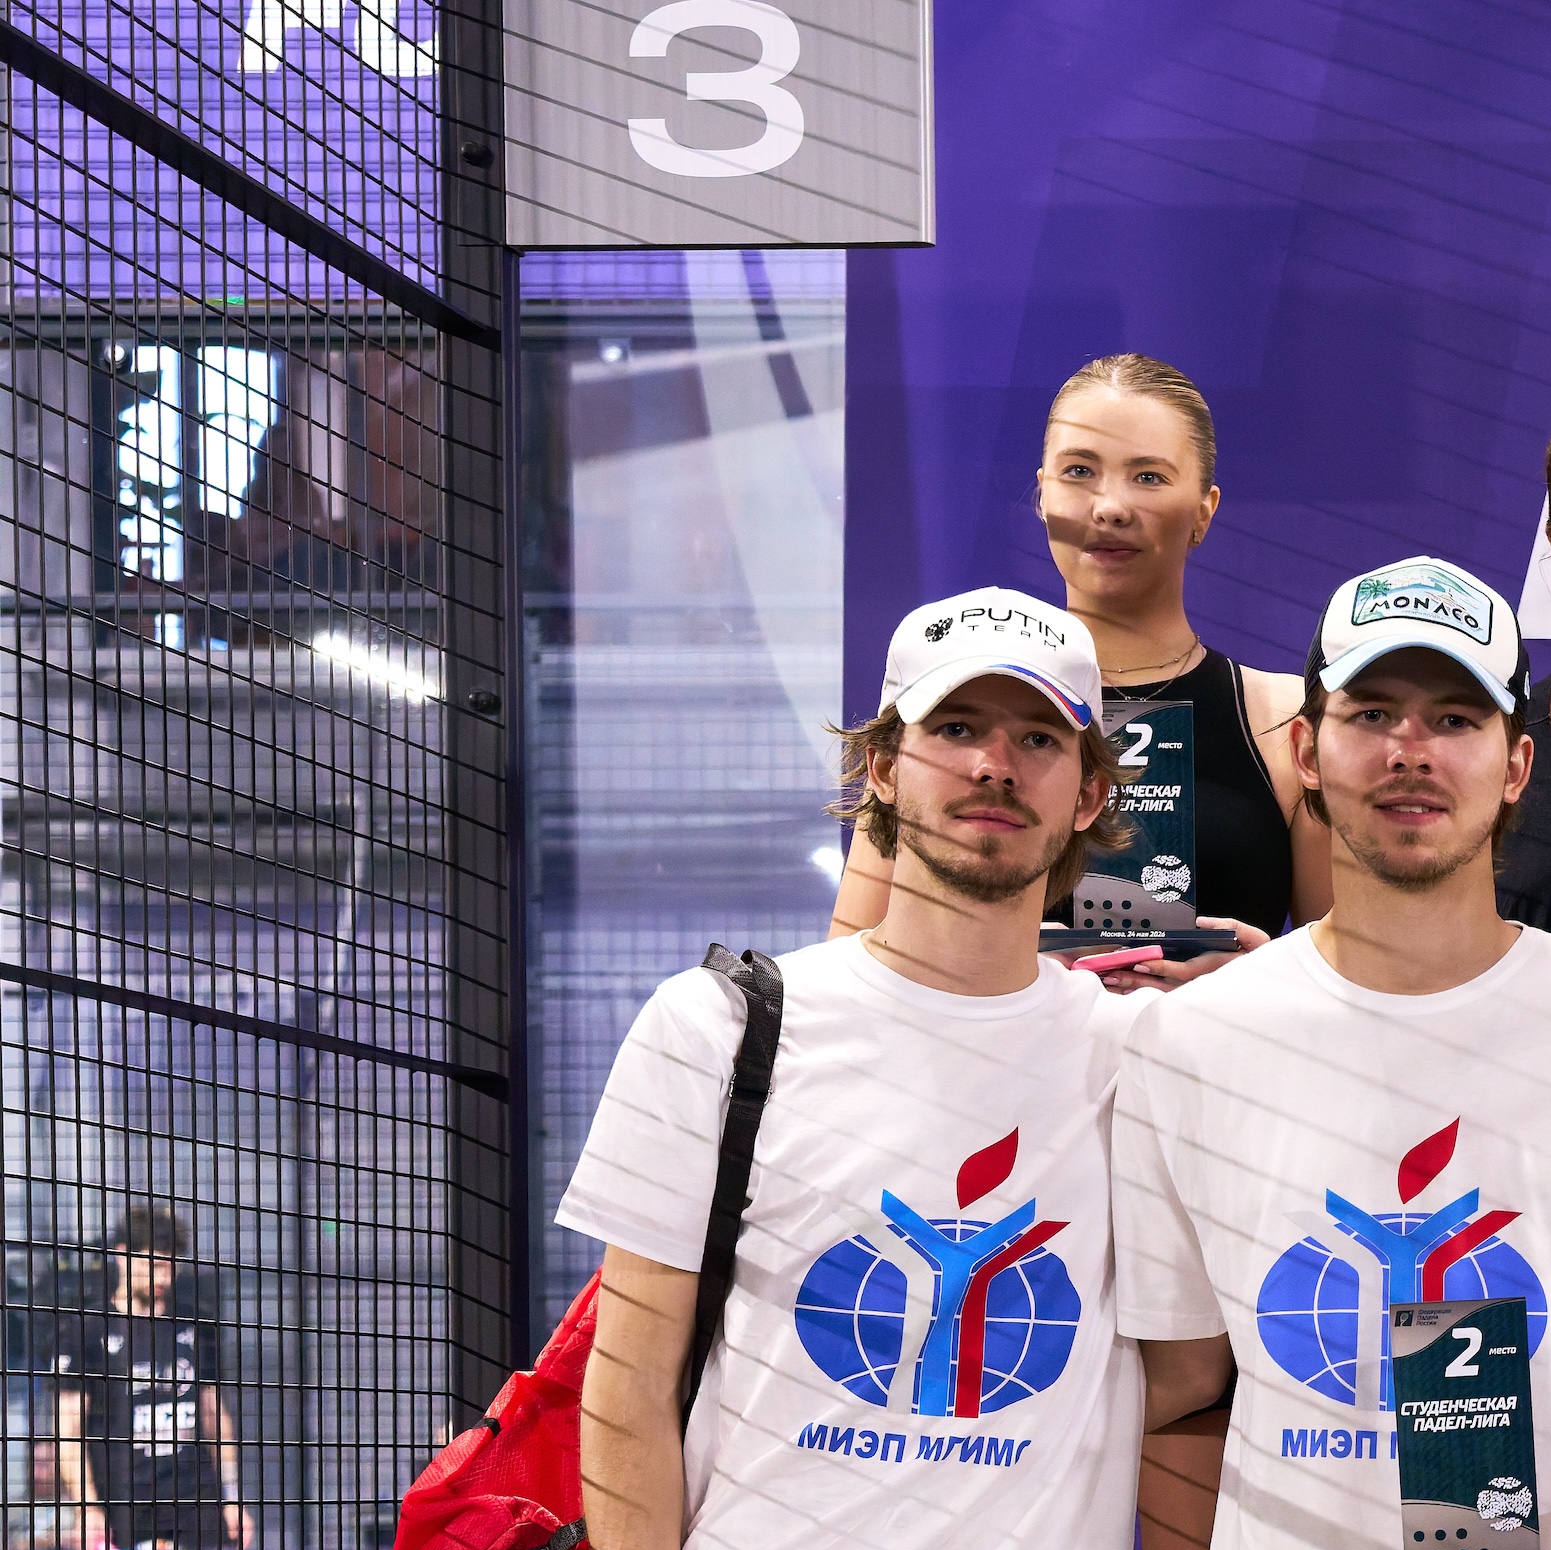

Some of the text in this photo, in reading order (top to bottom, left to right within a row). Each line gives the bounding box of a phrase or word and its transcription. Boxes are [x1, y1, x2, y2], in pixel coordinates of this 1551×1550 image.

[626, 0, 805, 178] 3
[961, 607, 1065, 645] PUTIN
[1369, 596, 1479, 629] MONACO
[967, 624, 1057, 651] TEAM
[1117, 722, 1183, 766] 2 место
[1444, 1327, 1517, 1378] 2 место
[1400, 1395, 1518, 1418] СТУДЕНЧЕСКАЯ
[1413, 1413, 1511, 1433] ПАДЕЛ-ЛИГА
[797, 1422, 907, 1464] МИЭП
[1281, 1428, 1378, 1459] МИЭП
